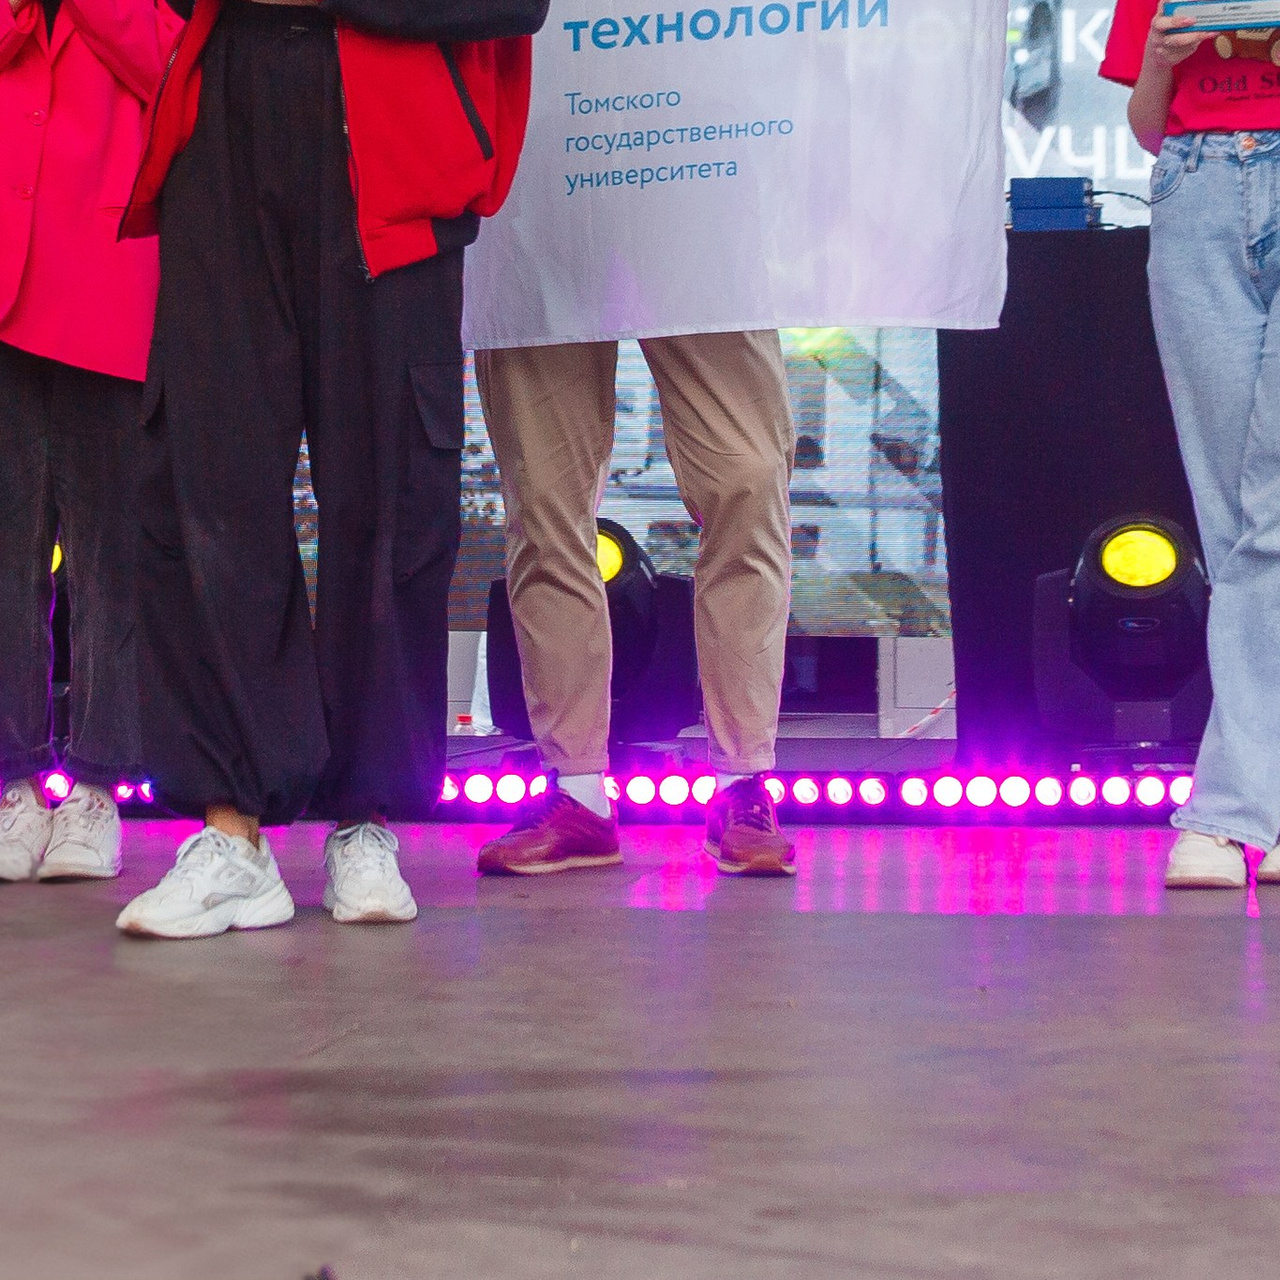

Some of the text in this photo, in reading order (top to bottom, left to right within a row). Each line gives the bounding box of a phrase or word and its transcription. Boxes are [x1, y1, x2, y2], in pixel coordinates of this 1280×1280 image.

[564, 90, 681, 116] Томского
[565, 119, 794, 155] государственного
[565, 160, 737, 196] университета
